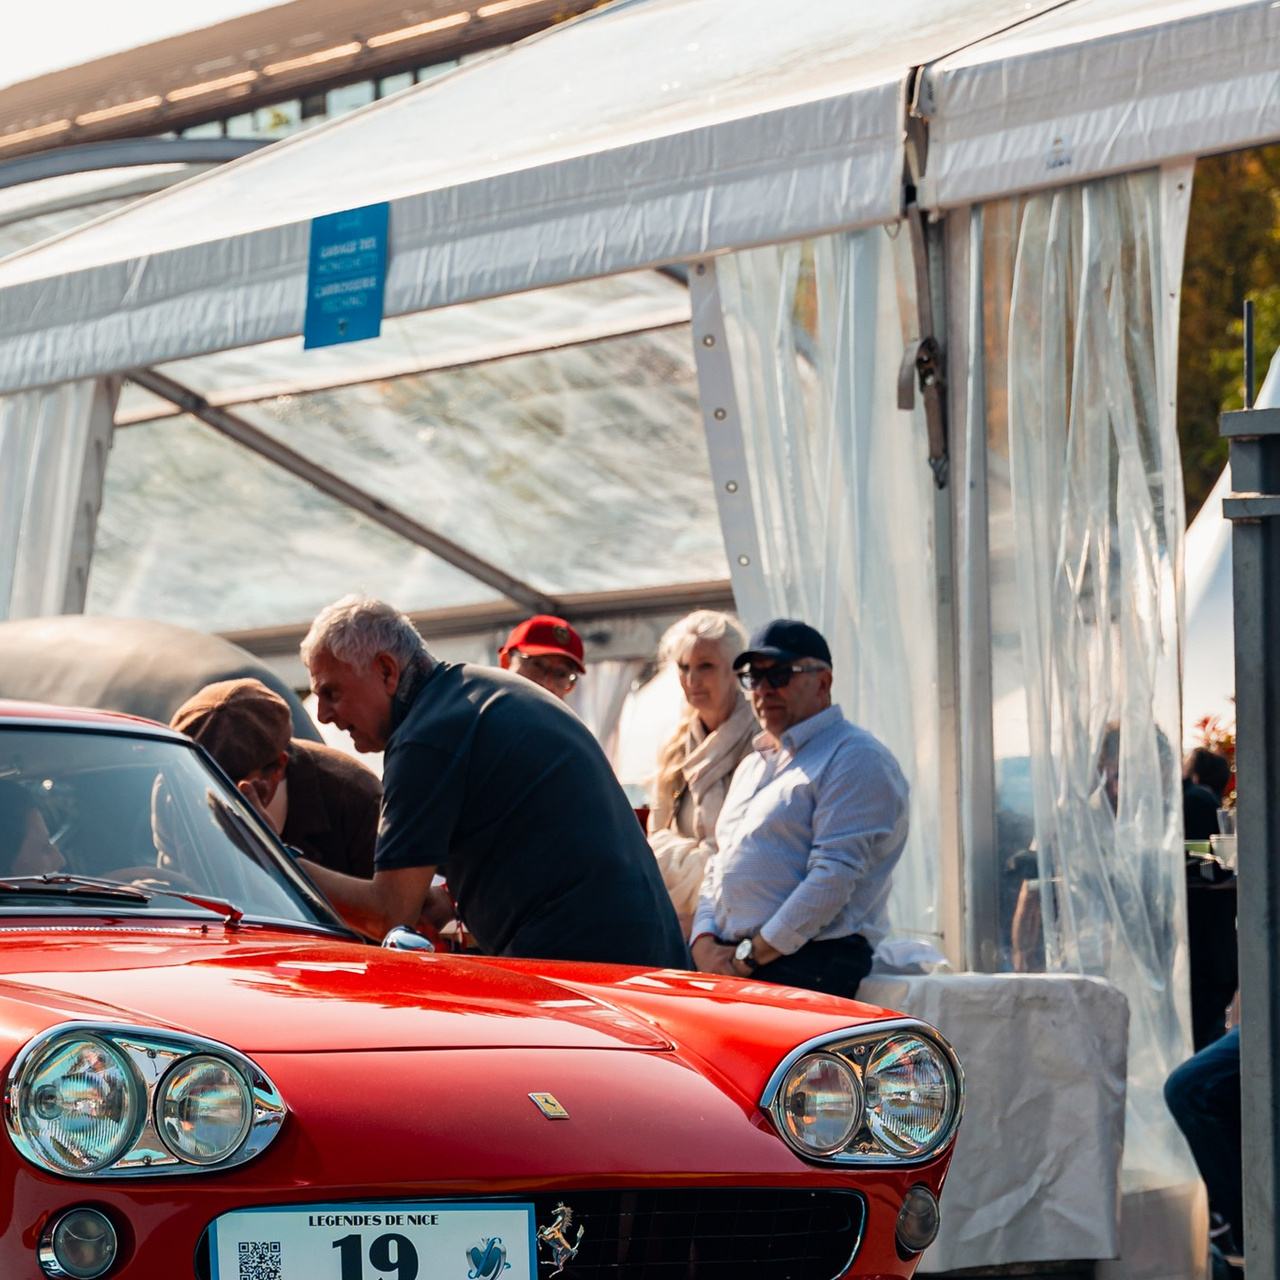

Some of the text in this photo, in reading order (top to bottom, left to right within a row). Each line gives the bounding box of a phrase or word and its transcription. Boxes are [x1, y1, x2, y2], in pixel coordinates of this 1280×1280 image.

[309, 1214, 439, 1227] LEGENDES DE NICE
